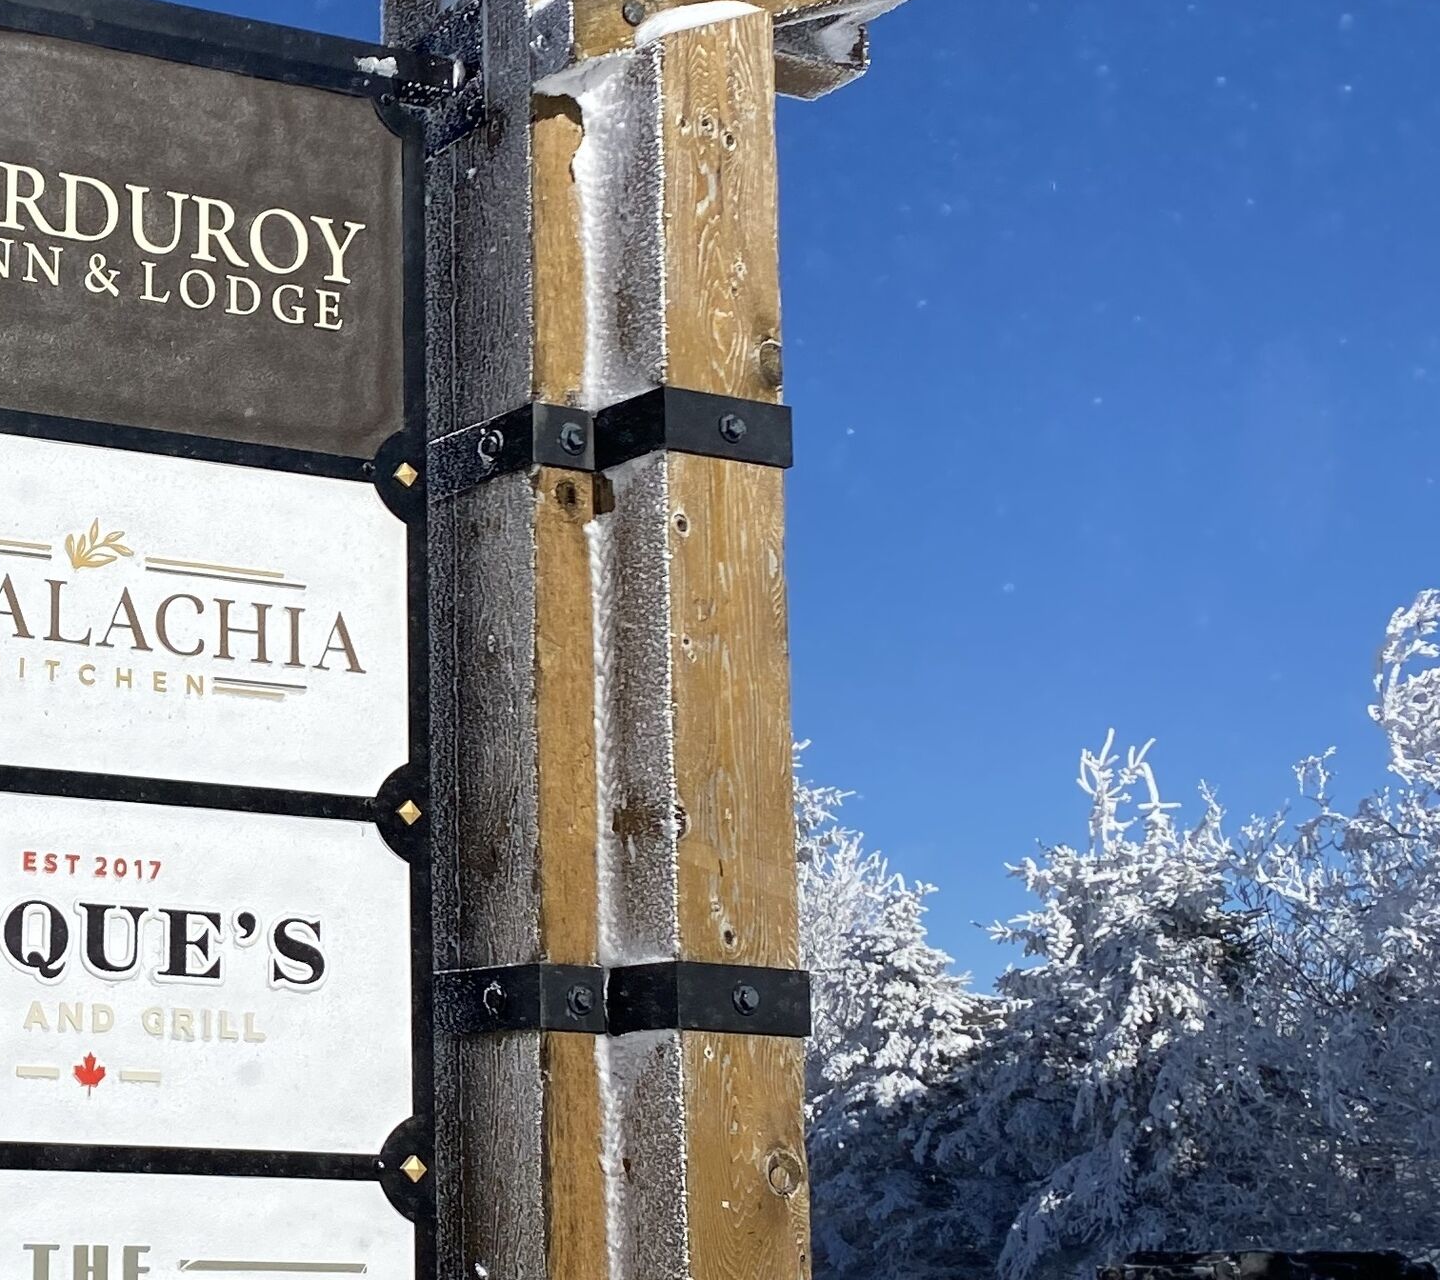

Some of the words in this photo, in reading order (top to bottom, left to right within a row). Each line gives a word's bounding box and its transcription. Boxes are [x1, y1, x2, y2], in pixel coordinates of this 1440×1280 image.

[84, 253, 121, 297] &
[139, 261, 344, 331] LODGE
[22, 850, 81, 877] EST
[94, 854, 164, 882] 2017
[23, 1001, 116, 1035] AND
[142, 1007, 267, 1043] GRILL
